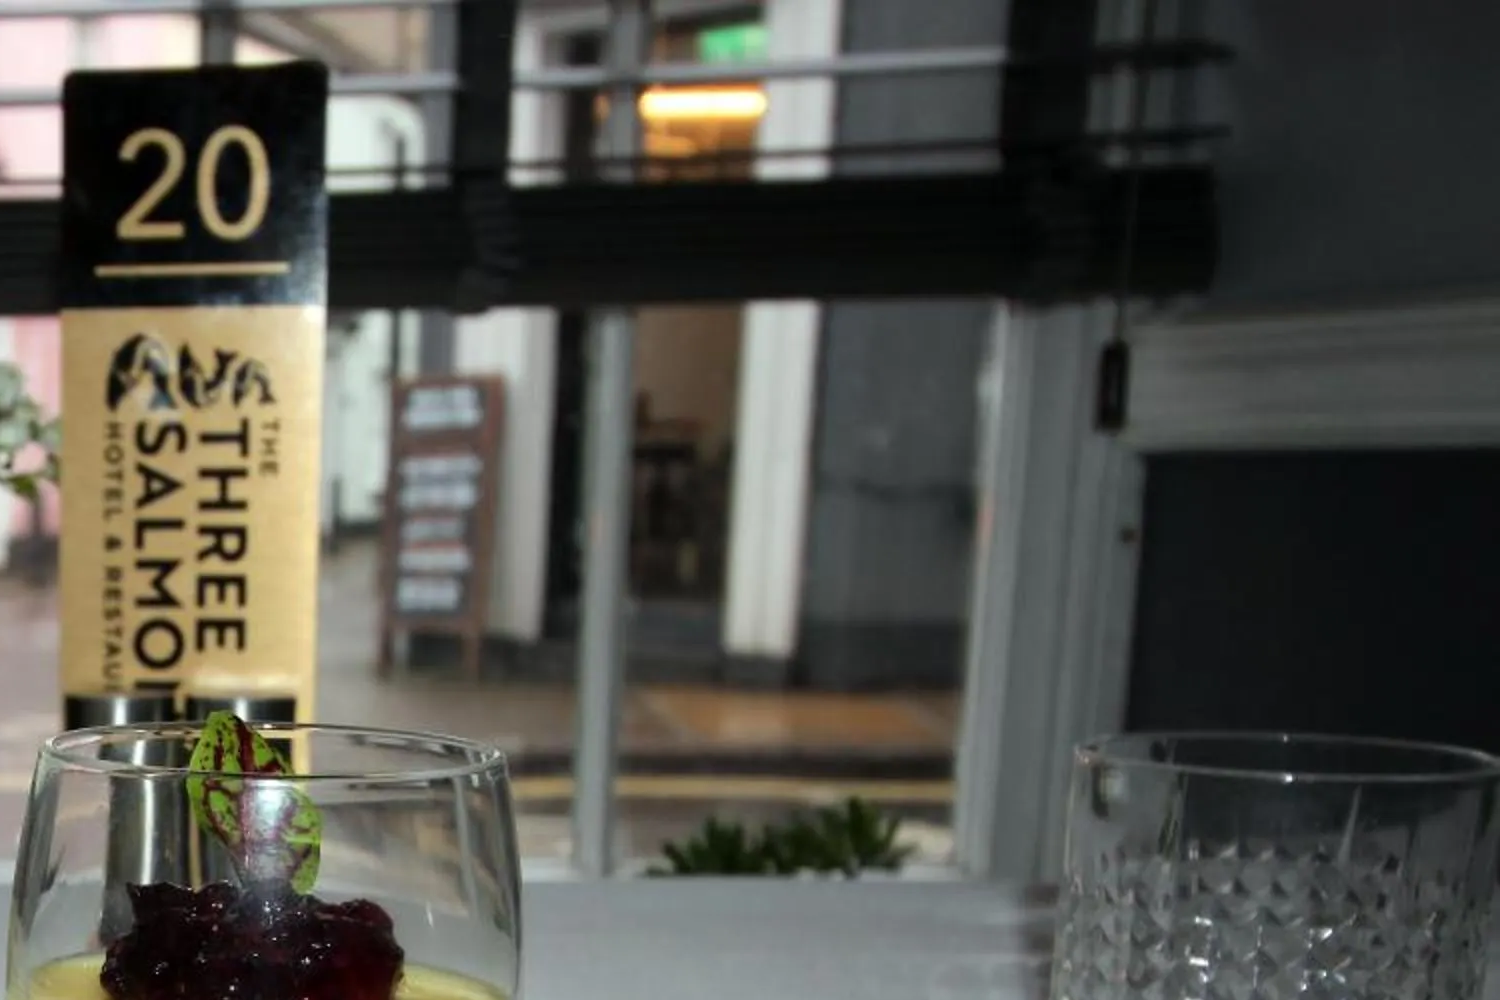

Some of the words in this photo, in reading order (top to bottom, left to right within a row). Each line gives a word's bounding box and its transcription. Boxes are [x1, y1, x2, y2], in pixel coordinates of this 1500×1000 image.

[116, 124, 270, 240] 20
[102, 421, 125, 521] HOTEL
[259, 417, 281, 476] THE
[103, 534, 123, 551] &
[195, 418, 250, 653] THREE
